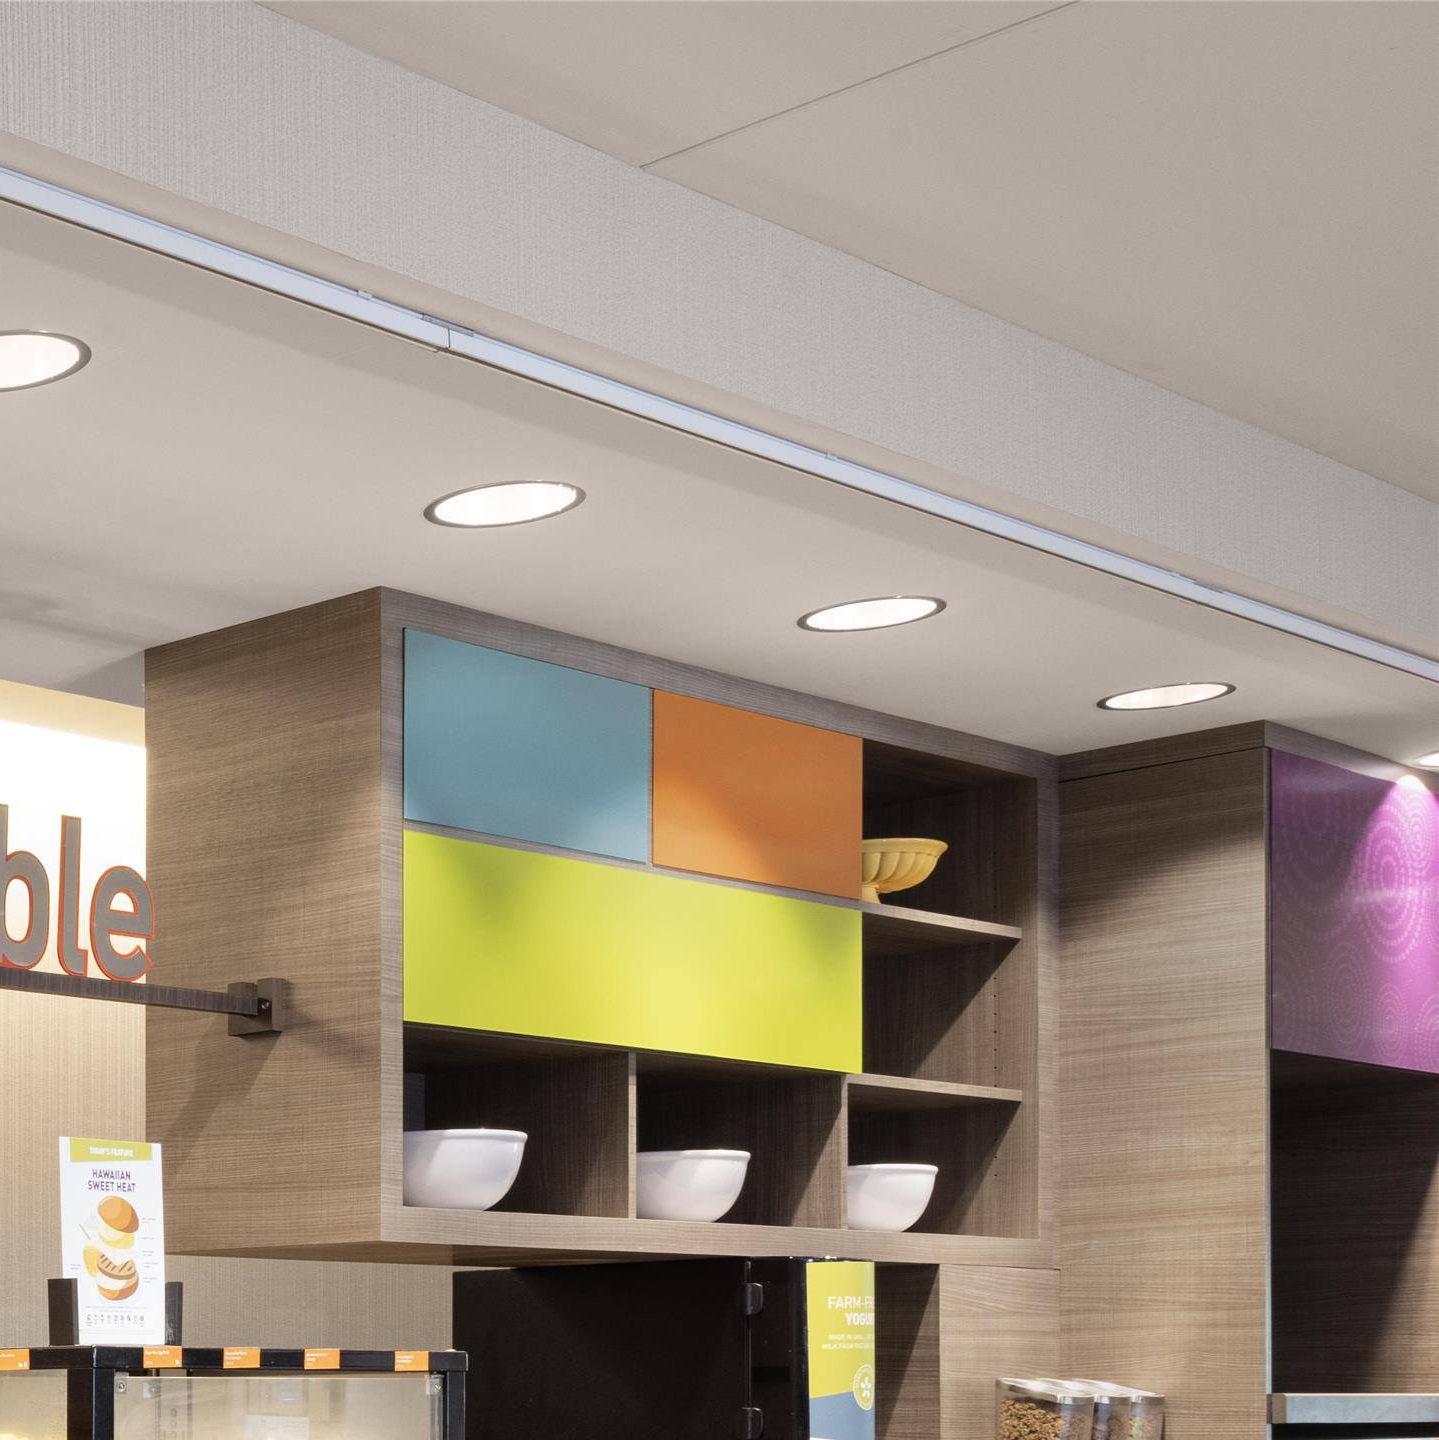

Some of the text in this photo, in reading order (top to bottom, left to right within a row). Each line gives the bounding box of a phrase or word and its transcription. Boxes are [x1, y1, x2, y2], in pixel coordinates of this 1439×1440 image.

[92, 1169, 131, 1180] HAWAIIAN
[88, 1181, 136, 1192] SWEET HEAT
